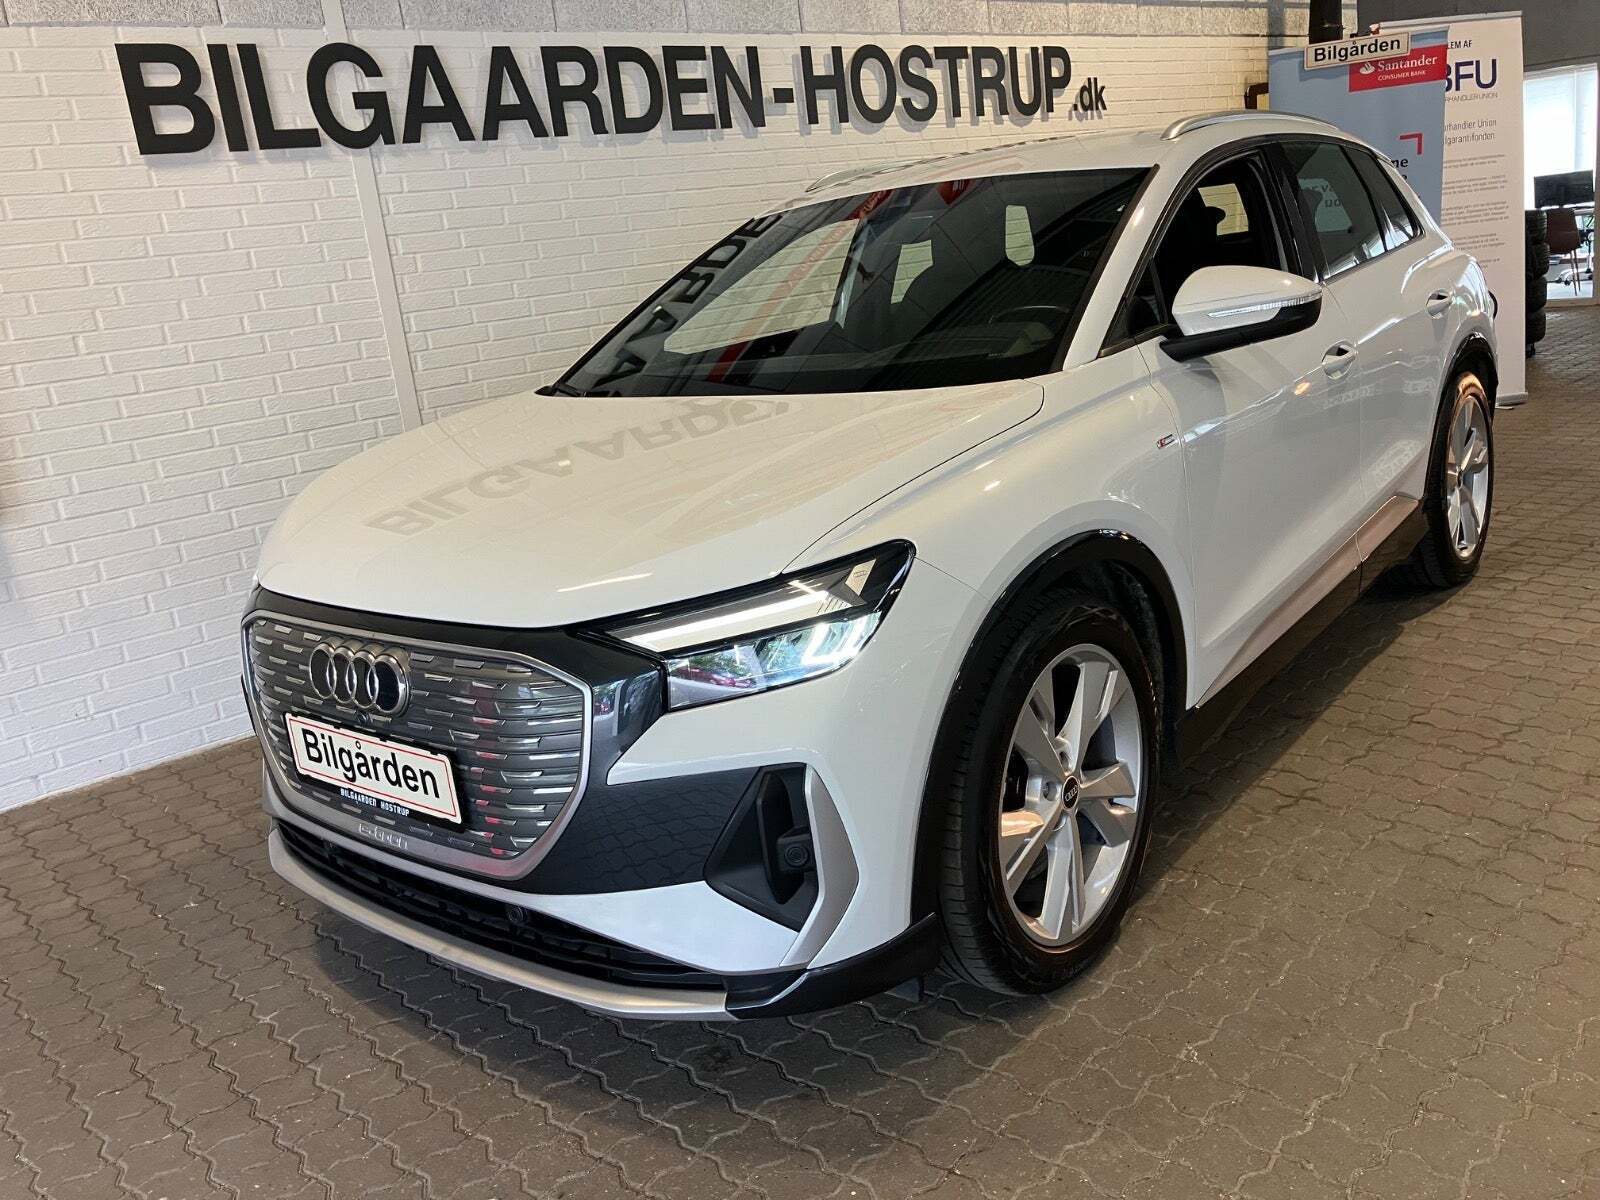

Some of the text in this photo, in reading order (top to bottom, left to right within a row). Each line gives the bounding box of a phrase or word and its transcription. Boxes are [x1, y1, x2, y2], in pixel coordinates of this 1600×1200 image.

[1314, 39, 1401, 62] Bilgården
[1446, 40, 1472, 50] EM AF
[1378, 55, 1437, 71] Santander
[1378, 72, 1410, 81] CONSUMER
[301, 728, 440, 799] Bilgården
[340, 787, 410, 817] BILGAARDEN HOSTRUP
